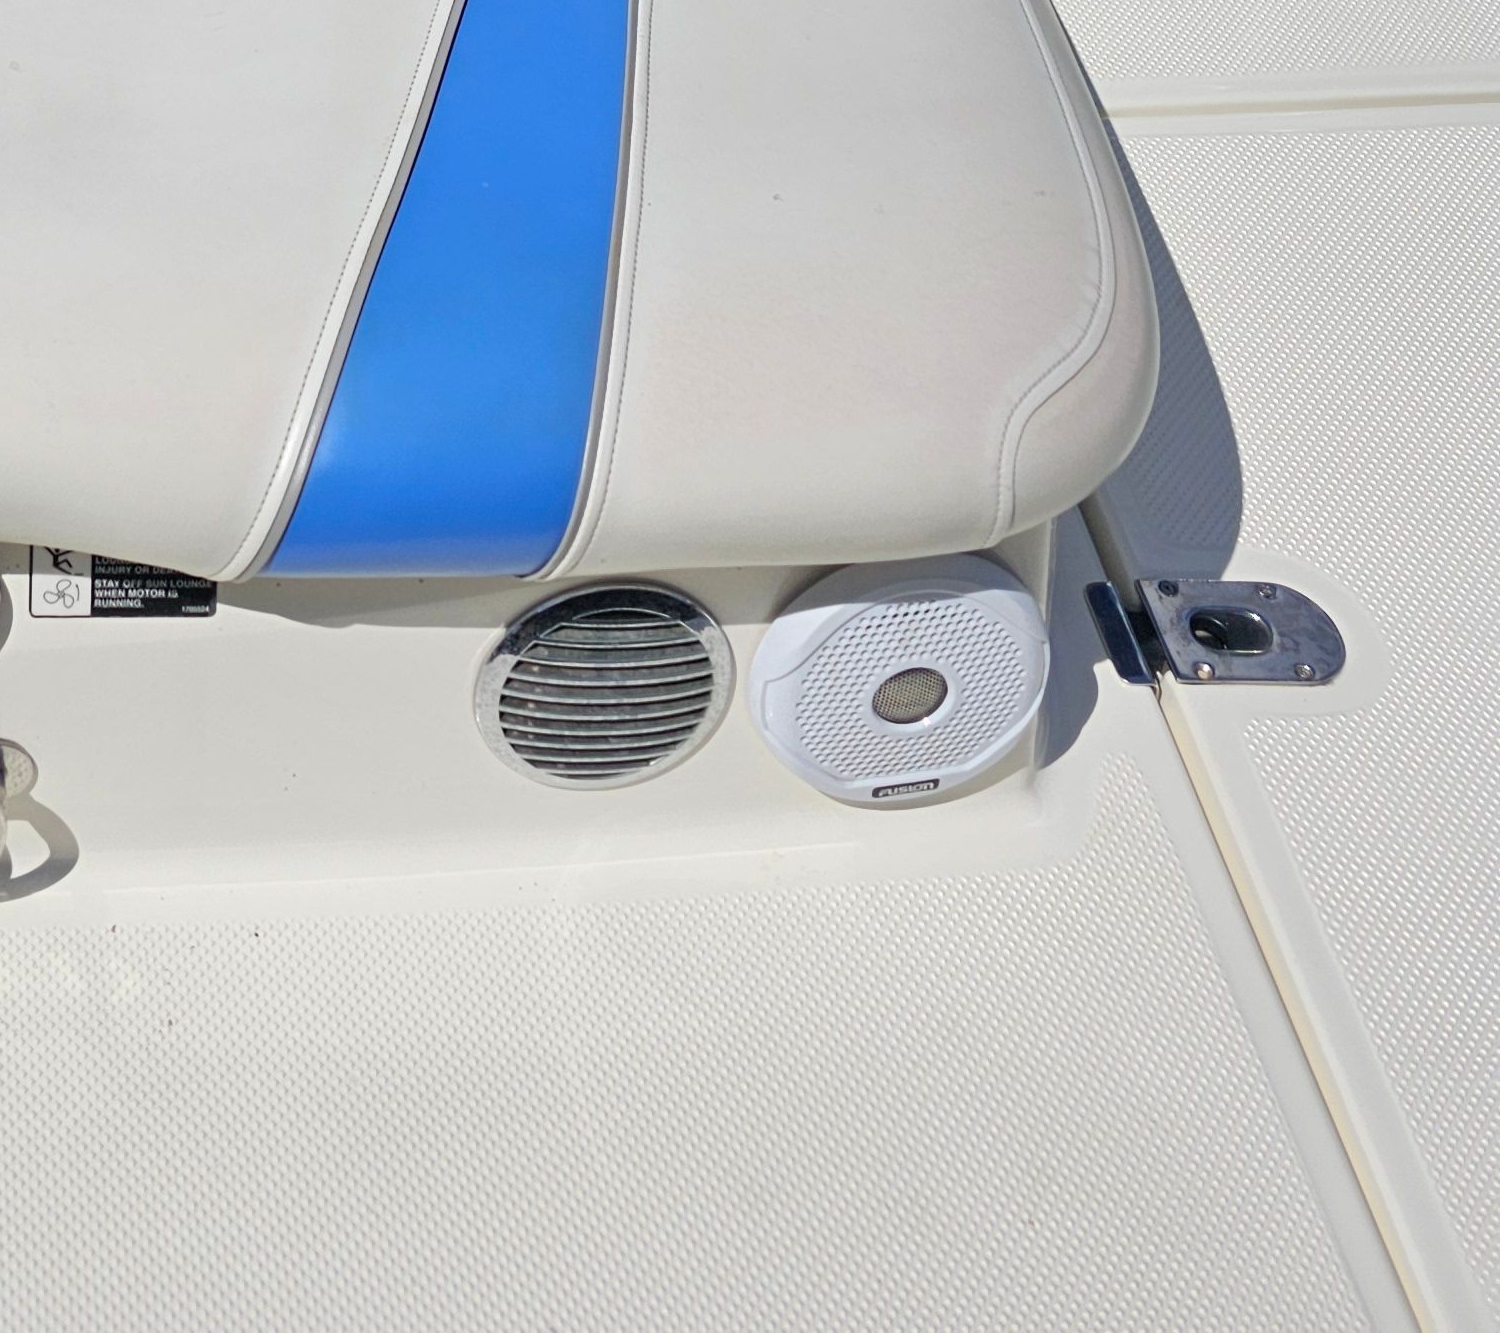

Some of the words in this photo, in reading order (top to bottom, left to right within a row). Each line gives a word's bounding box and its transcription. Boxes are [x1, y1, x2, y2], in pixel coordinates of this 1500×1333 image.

[95, 565, 133, 574] INJURY
[135, 565, 150, 574] OR
[94, 579, 120, 588] STAY
[122, 579, 143, 588] OFF
[146, 580, 168, 588] SUN
[170, 580, 213, 589] LOUNGE
[94, 589, 125, 598] WHEN
[128, 589, 166, 598] MOTOR
[168, 589, 179, 598] IS
[94, 599, 144, 608] RUNNING.
